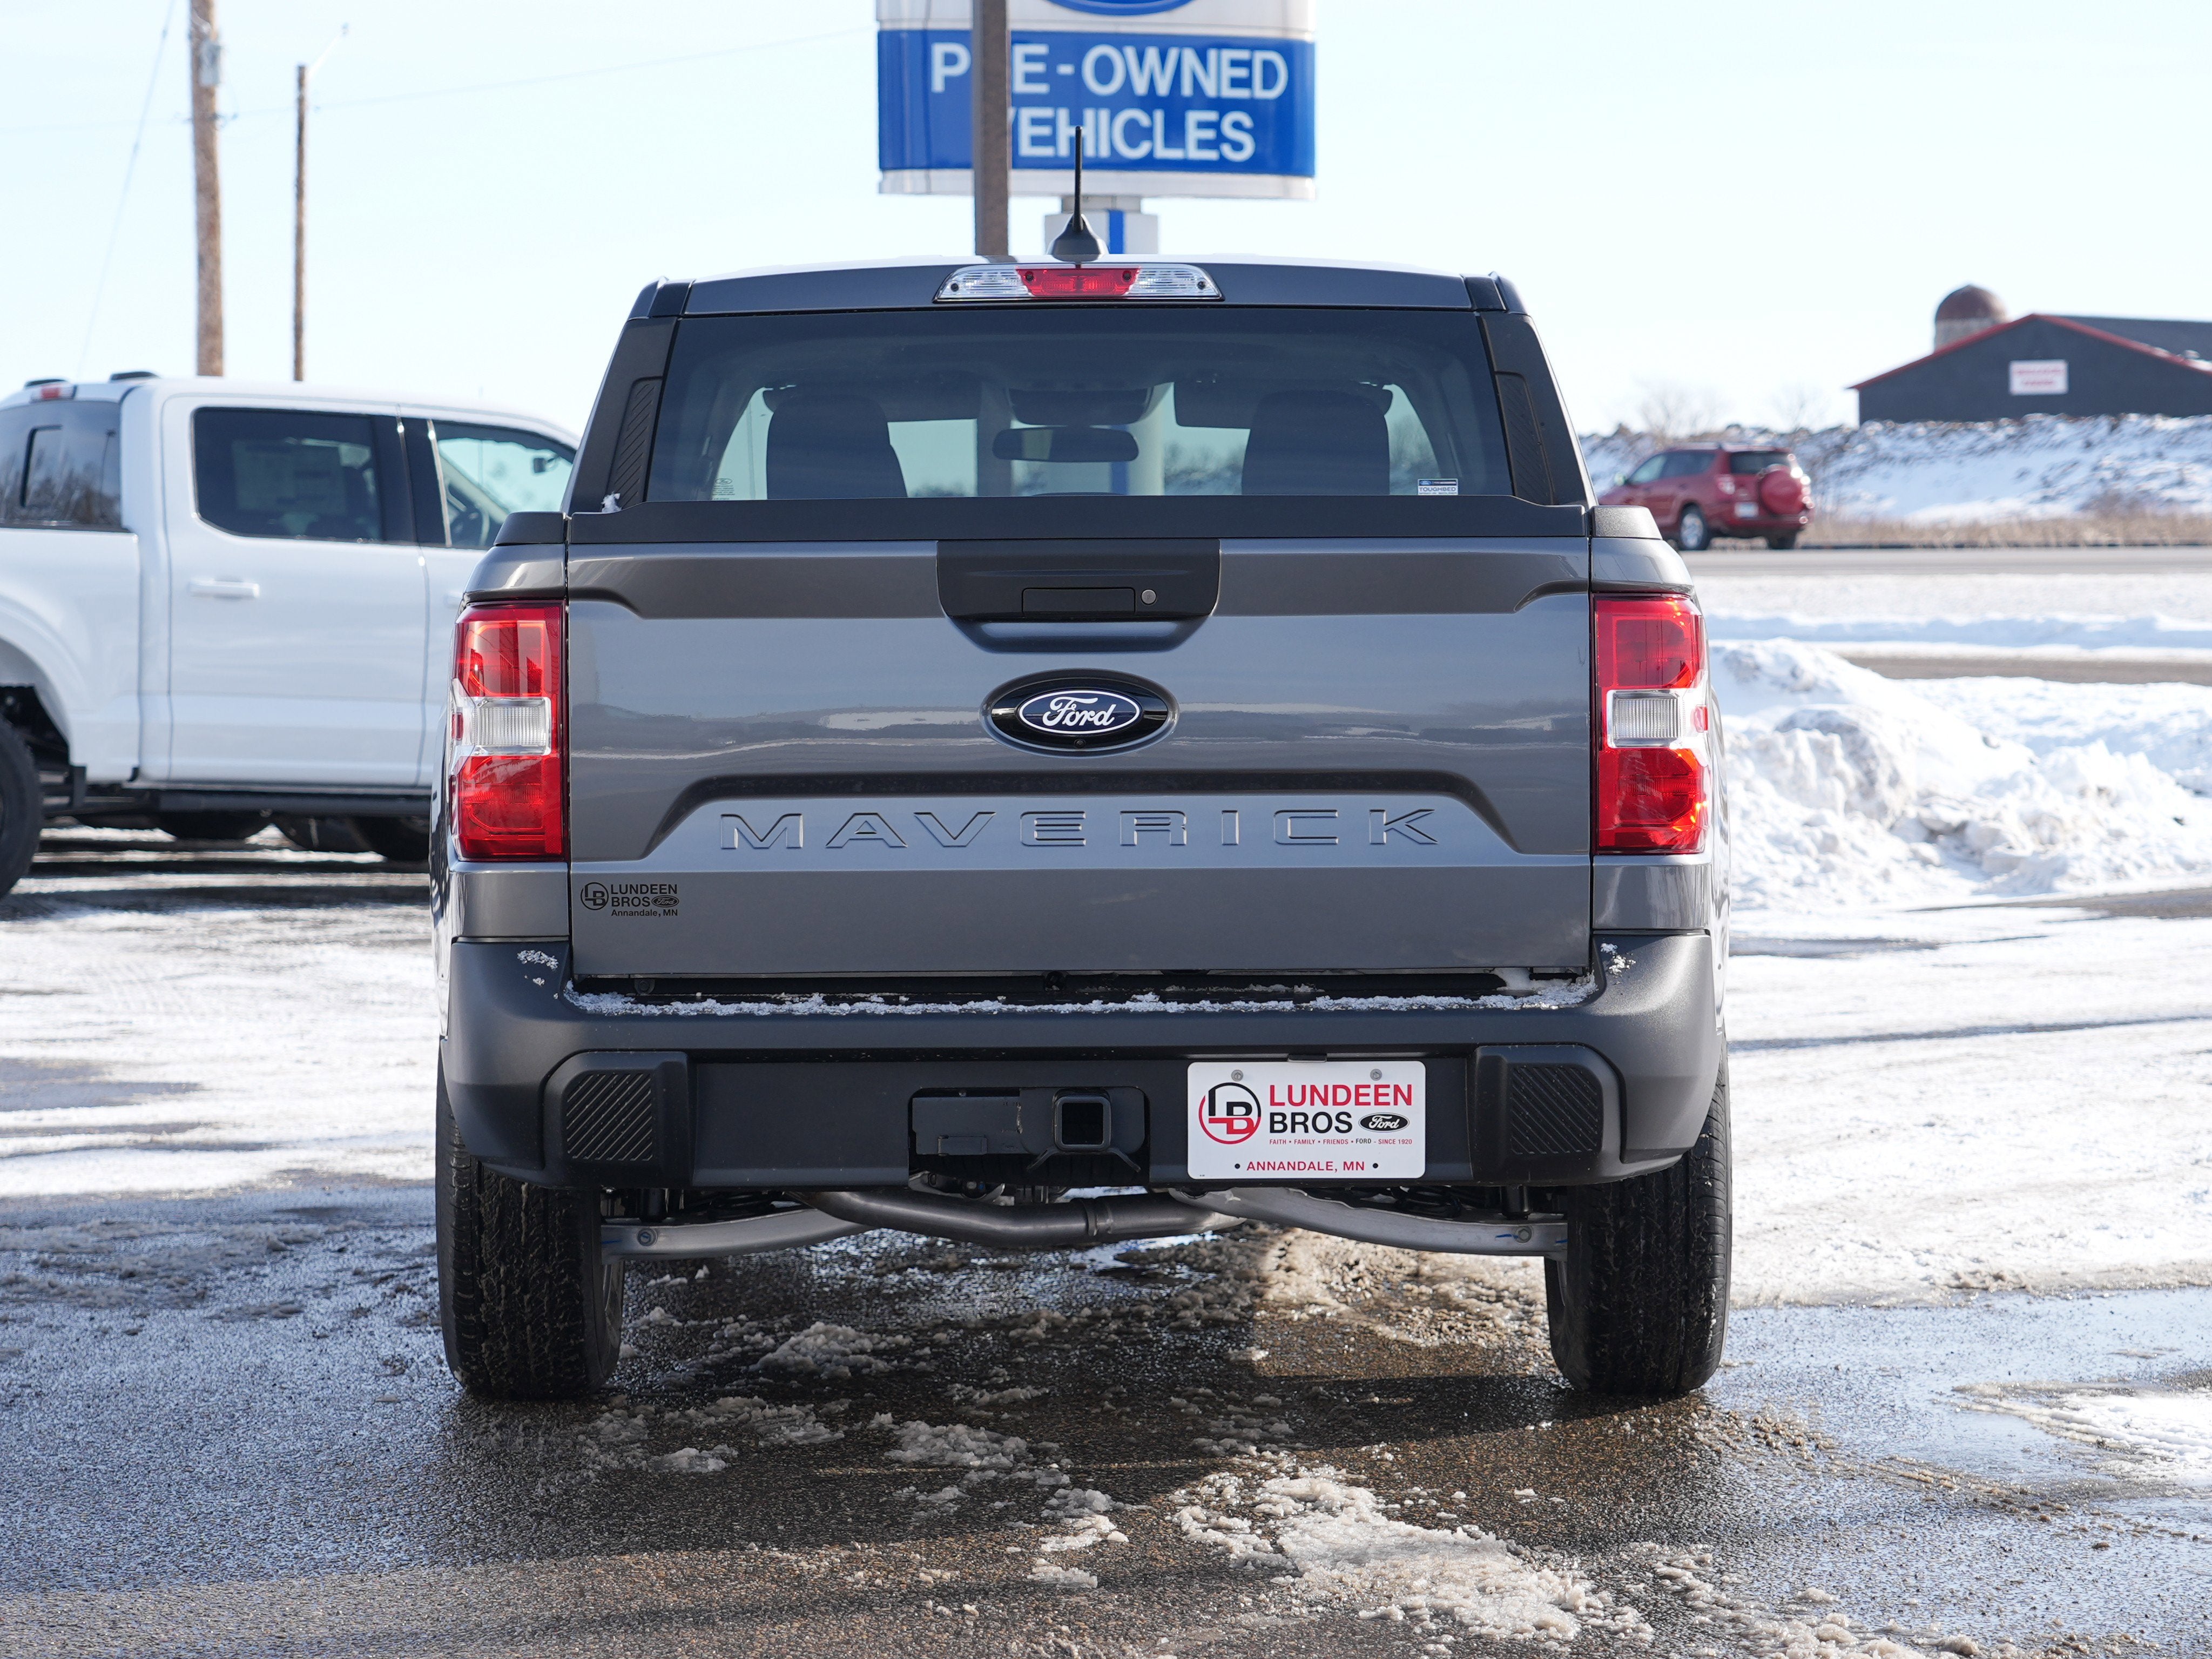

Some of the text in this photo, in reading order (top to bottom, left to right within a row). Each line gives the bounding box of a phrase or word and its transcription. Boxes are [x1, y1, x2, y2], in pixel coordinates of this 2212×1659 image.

[930, 42, 1289, 100] PE-OWNED
[1010, 106, 1256, 163] EHICLES
[1041, 696, 1116, 727] Ford
[720, 809, 1439, 850] MAVERICK
[611, 885, 677, 894] LUNDEEN
[612, 897, 650, 907] BROS
[1270, 1085, 1412, 1106] LUNDEEN
[1269, 1111, 1400, 1134] BROS Ford
[1246, 1161, 1365, 1172] ANNANDALE, MN
